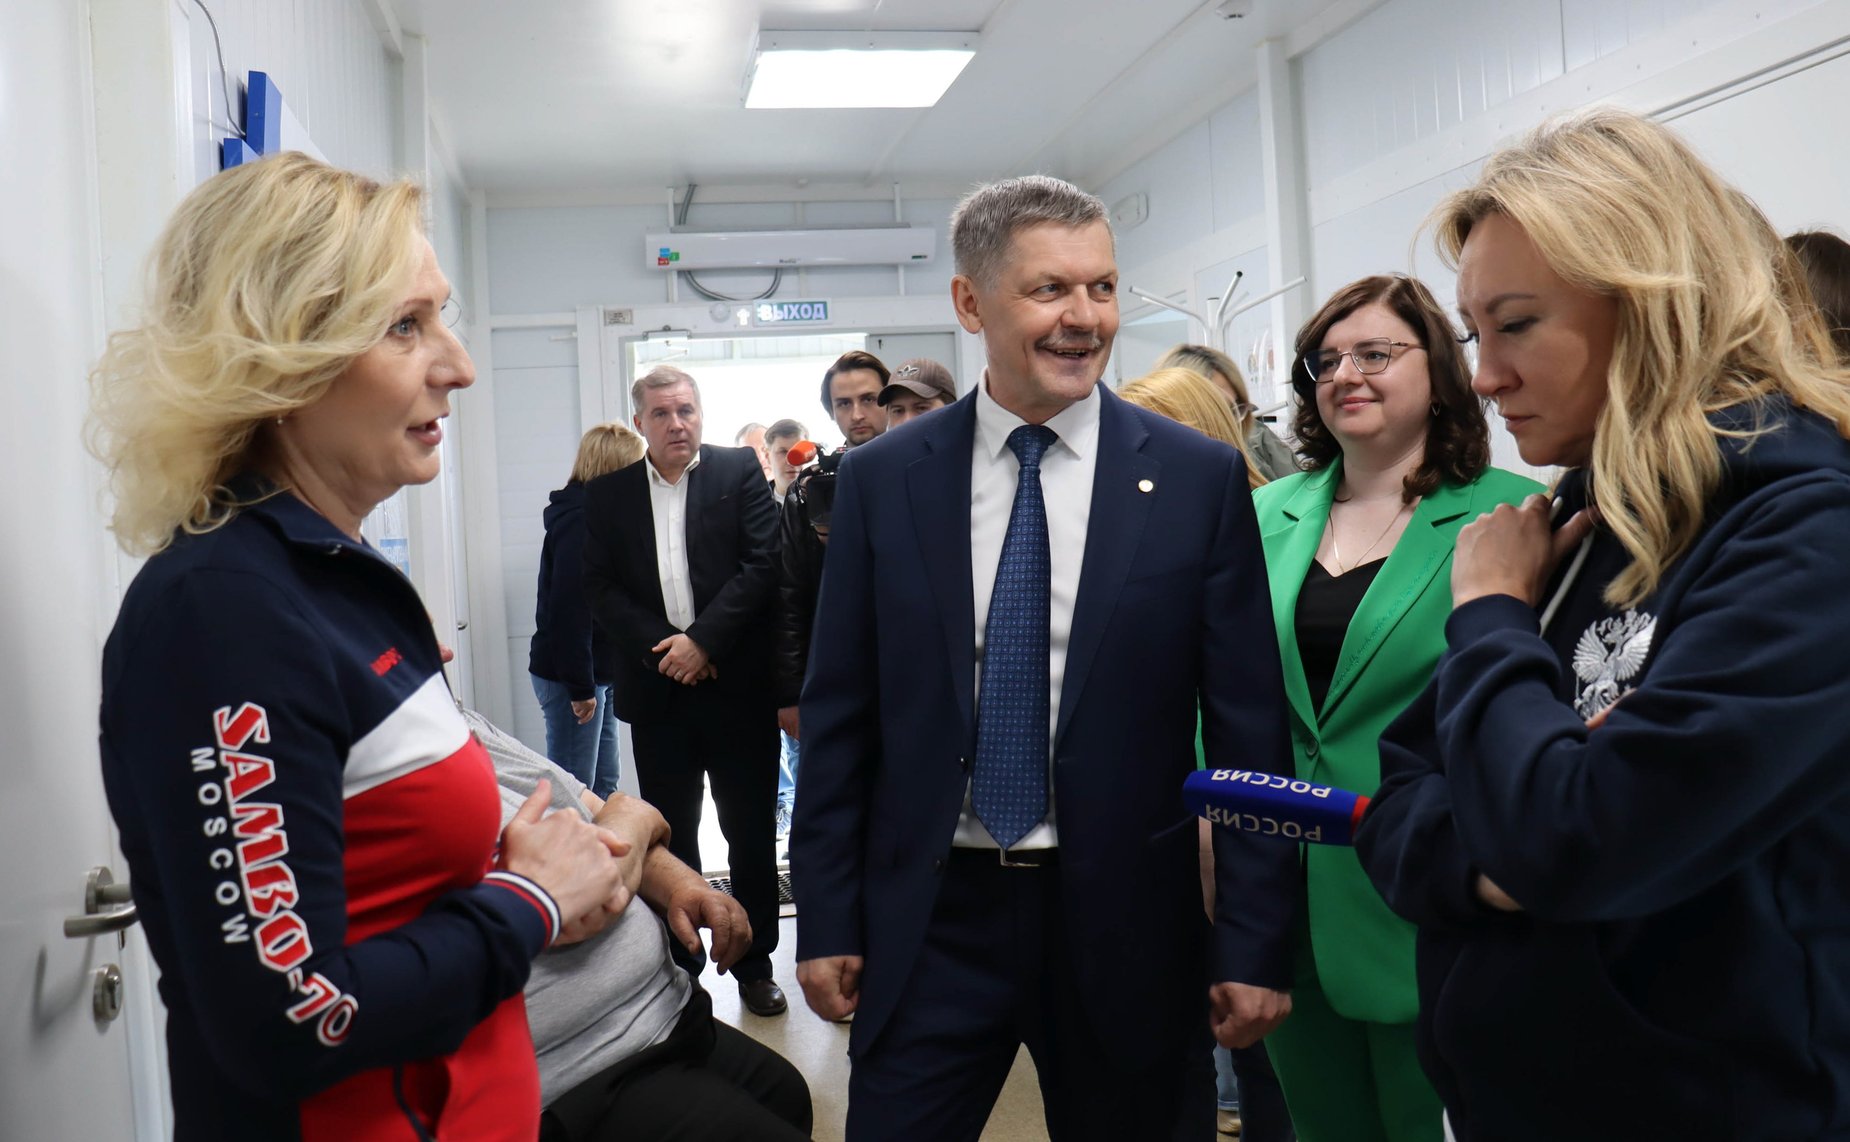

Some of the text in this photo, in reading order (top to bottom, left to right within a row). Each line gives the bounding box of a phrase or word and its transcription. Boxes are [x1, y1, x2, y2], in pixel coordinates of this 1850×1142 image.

[758, 303, 826, 322] ВЫХОД
[1211, 769, 1332, 798] РОССИЯ
[1205, 804, 1321, 842] РОССИЯ
[191, 747, 250, 943] MOSCOW
[213, 702, 358, 1046] SAMBO-70
